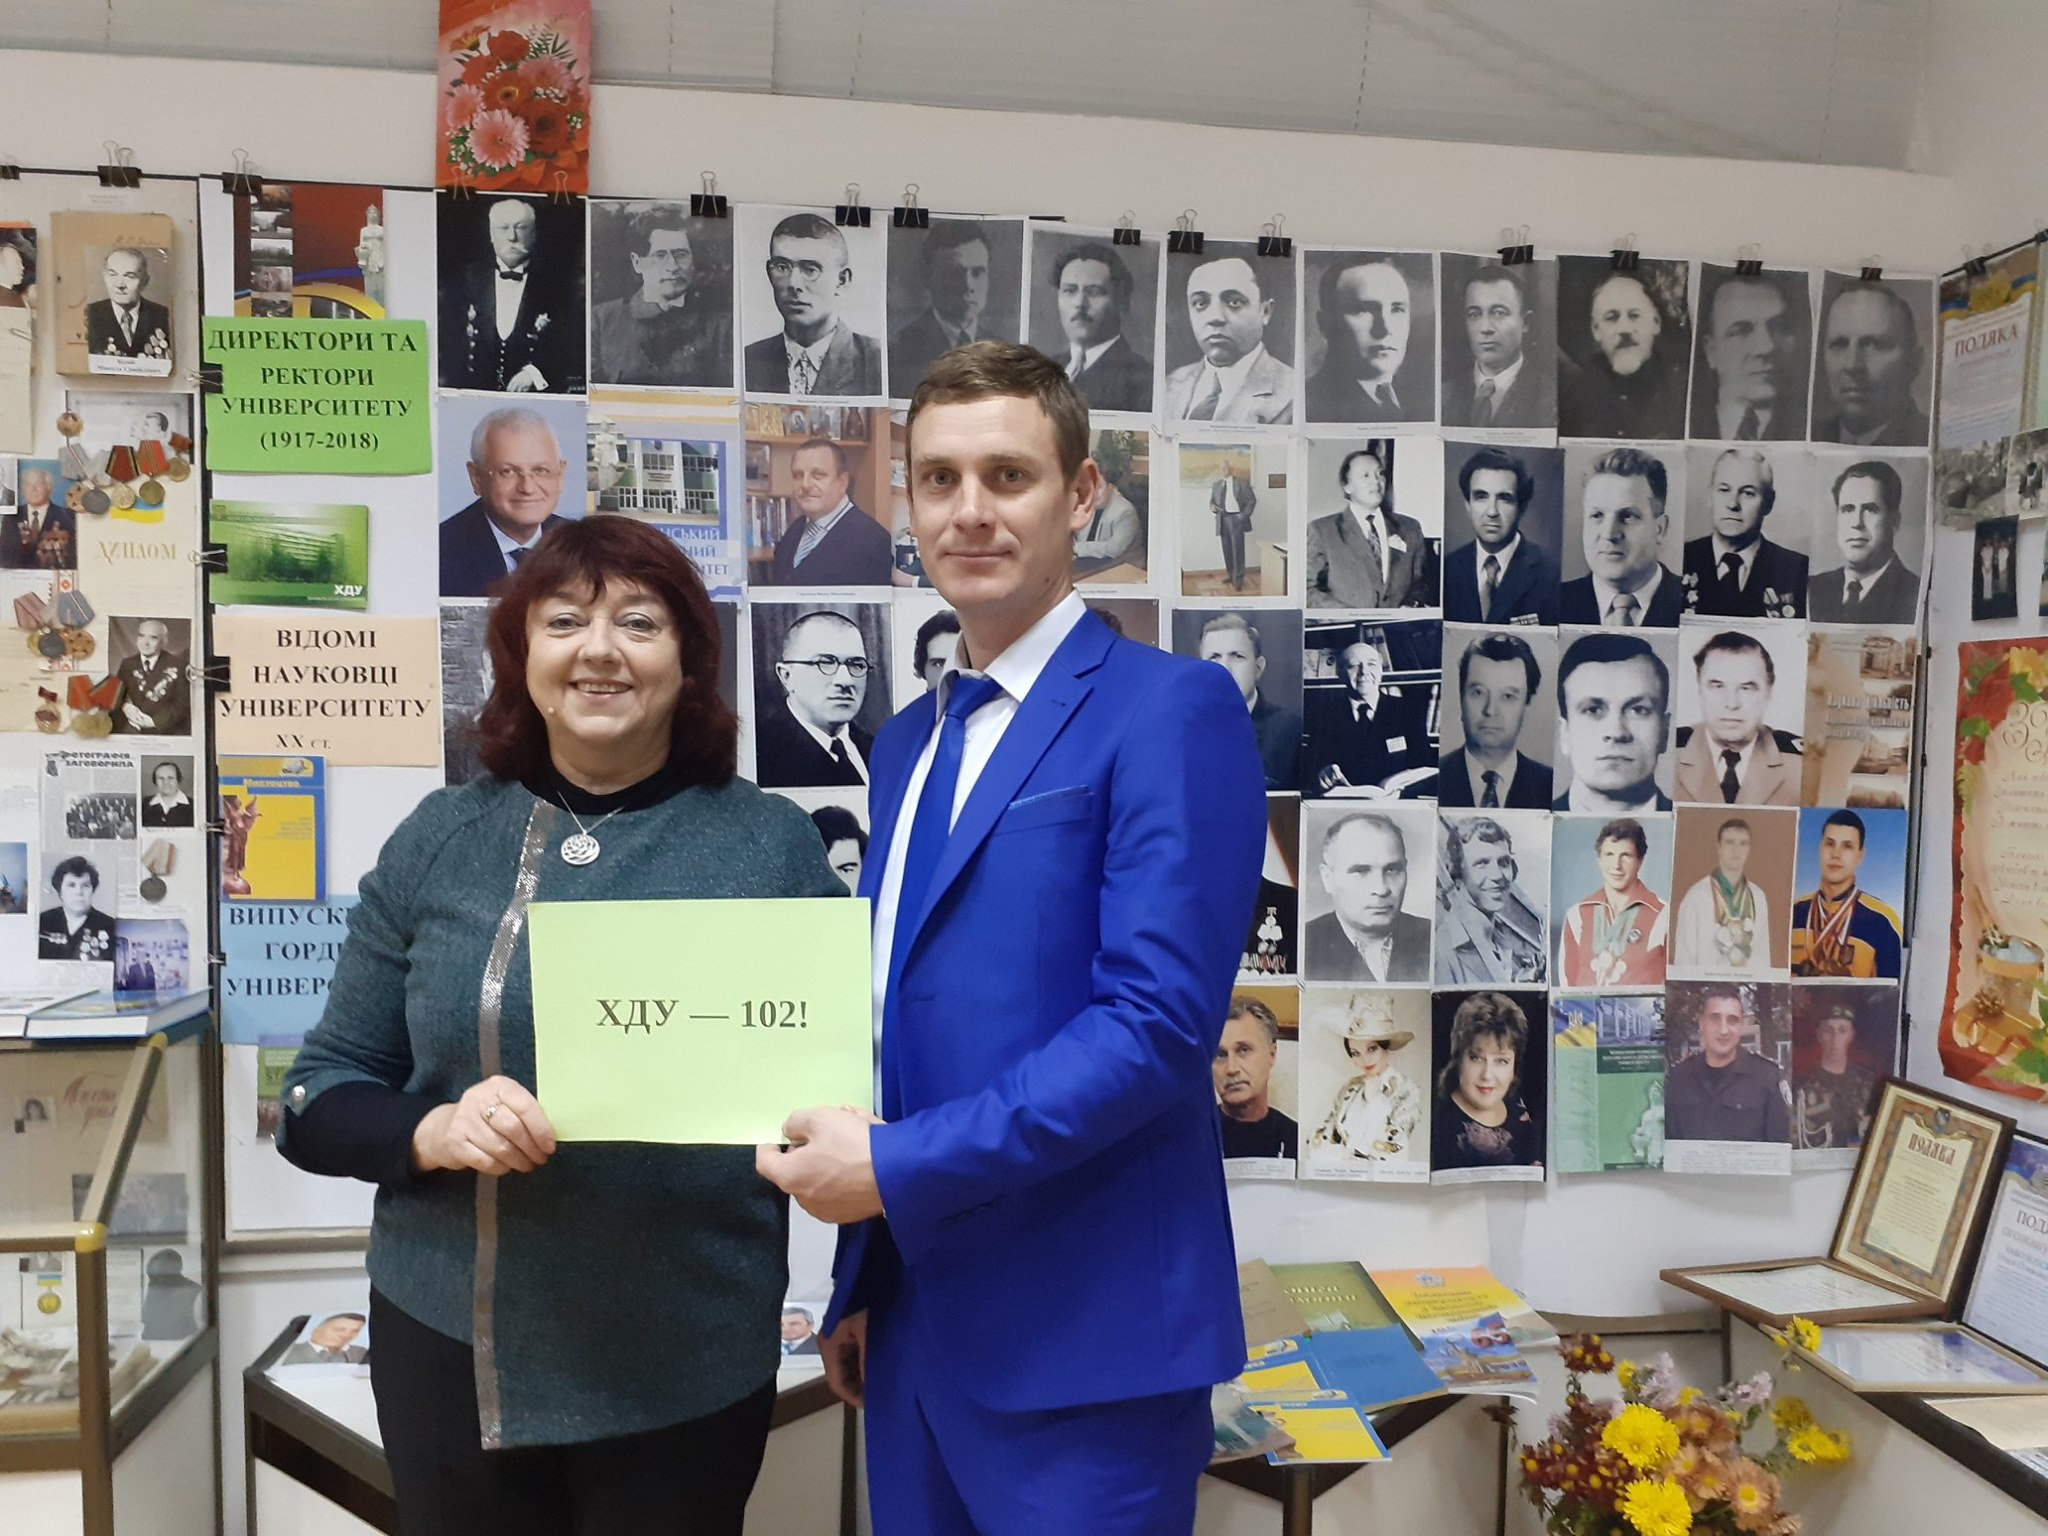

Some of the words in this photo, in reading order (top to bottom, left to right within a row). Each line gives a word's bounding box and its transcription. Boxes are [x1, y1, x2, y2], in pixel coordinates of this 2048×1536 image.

[208, 330, 373, 351] ДИРЕКТОРИ
[381, 332, 418, 352] ТА
[261, 367, 375, 386] РЕКТОРИ
[222, 397, 412, 417] УНІВЕРСИТЕТУ
[260, 431, 379, 451] (1917-2018)
[334, 584, 363, 597] ХДУ
[277, 629, 378, 652] ВІДОМІ
[253, 665, 399, 687] НАУКОВЦІ
[219, 699, 432, 718] УНІВЕРСИТЕТУ
[229, 907, 350, 926] ВИПУСК
[265, 942, 344, 962] ГОРД
[596, 998, 679, 1034] ХДУ
[741, 1000, 808, 1029] 102!
[2016, 1210, 2048, 1234] ПОД
